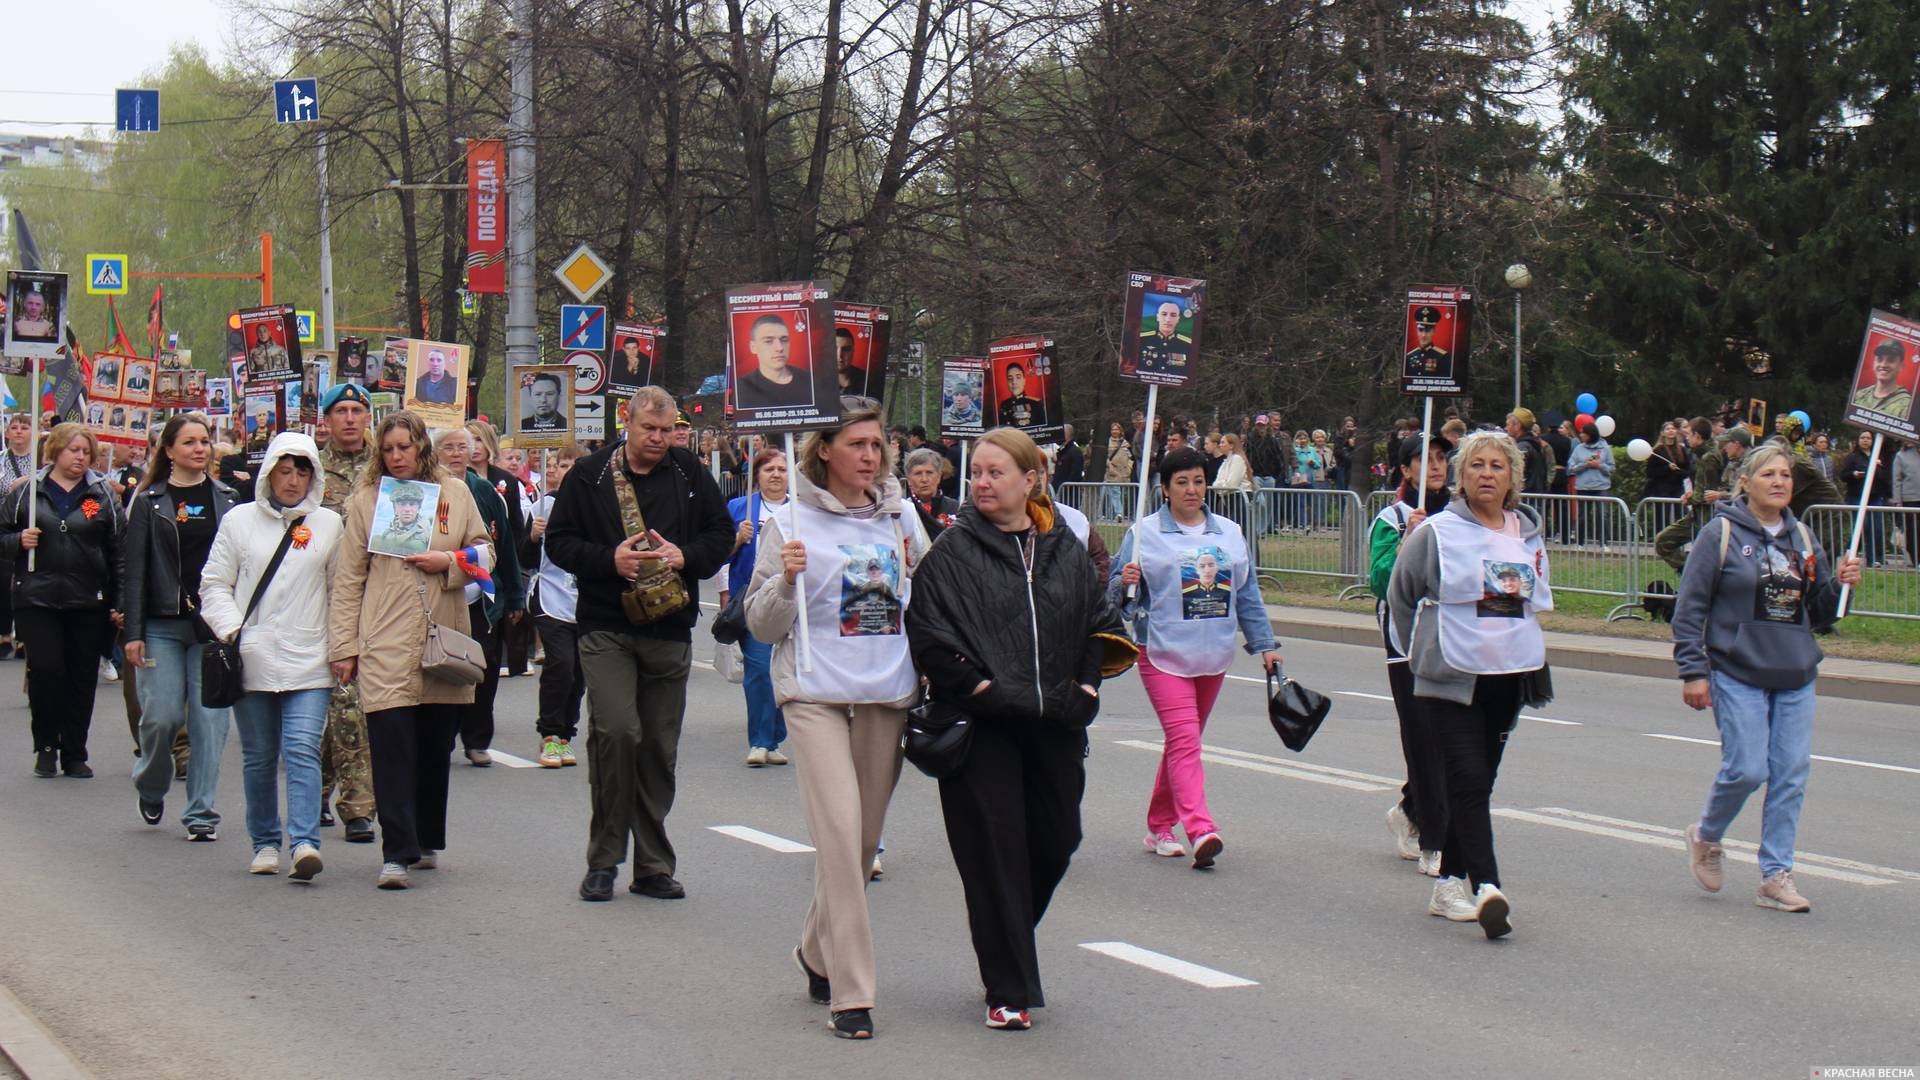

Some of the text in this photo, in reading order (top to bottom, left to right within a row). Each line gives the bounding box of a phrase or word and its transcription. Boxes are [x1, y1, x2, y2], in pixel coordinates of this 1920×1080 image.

[478, 160, 498, 240] ПОБЕДА!
[729, 291, 829, 304] БЕССМЕРТНЫЙ ПОЛК СВО
[990, 343, 1024, 353] БЕССМЕРТНЫЙ
[772, 418, 804, 426] АЛЕКСАНДР
